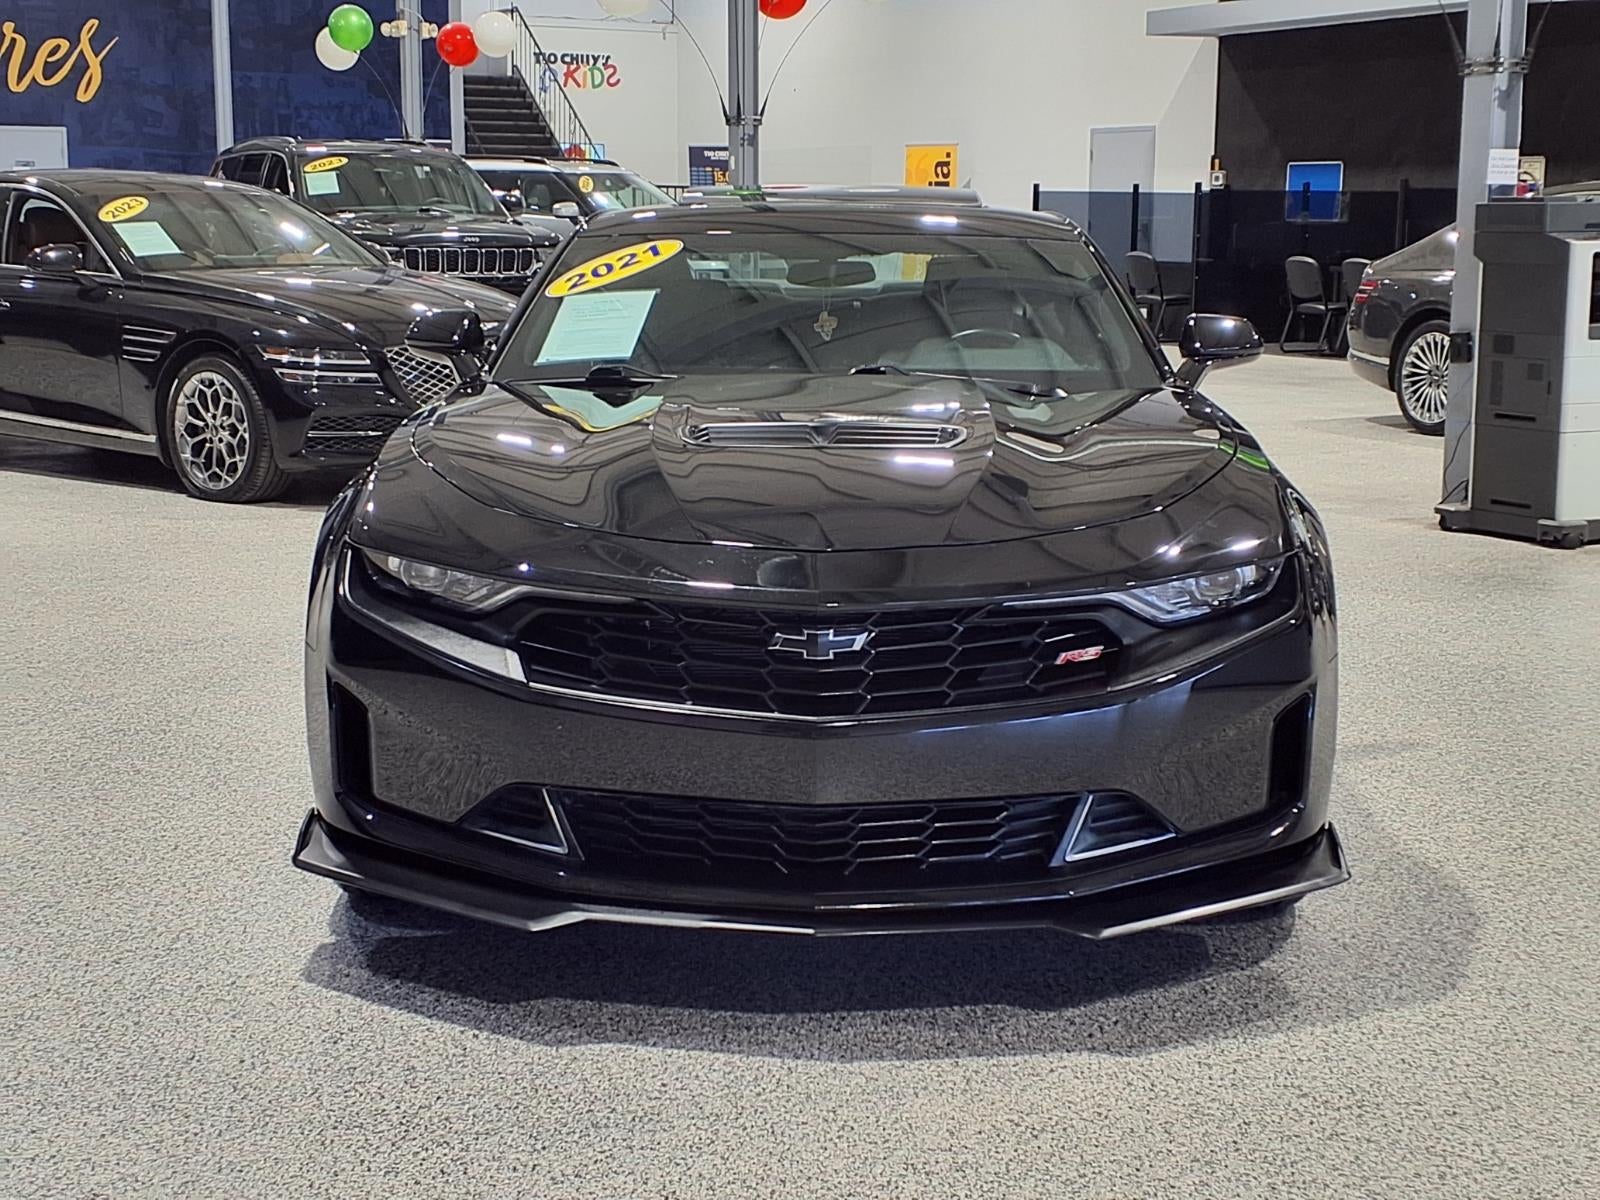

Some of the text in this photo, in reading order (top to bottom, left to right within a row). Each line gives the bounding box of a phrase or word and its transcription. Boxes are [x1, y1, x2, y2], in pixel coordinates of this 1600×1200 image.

[533, 52, 558, 65] TIO
[105, 198, 144, 219] 2023
[565, 244, 662, 292] 2021
[1054, 645, 1104, 665] RS
